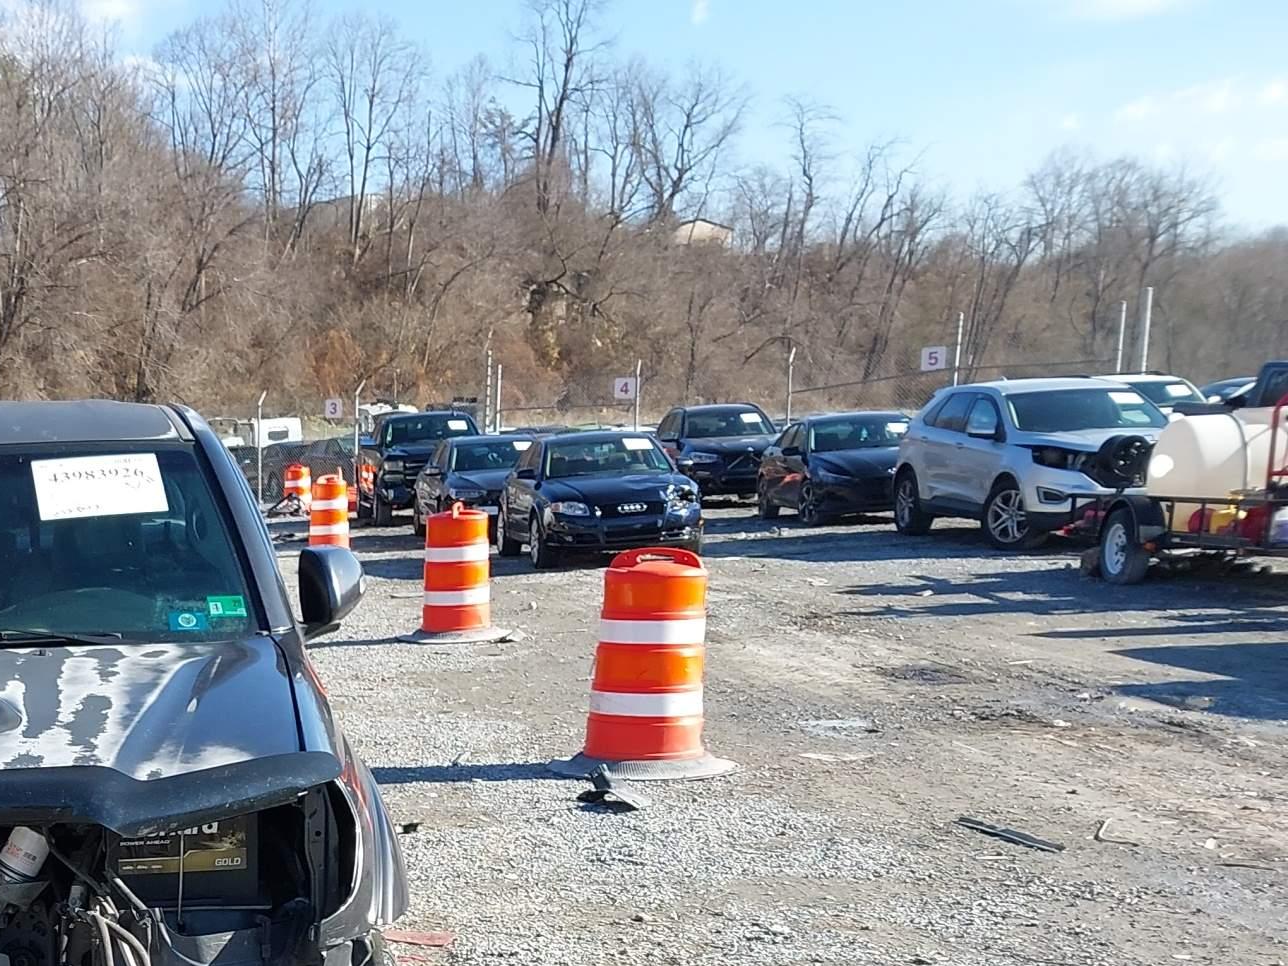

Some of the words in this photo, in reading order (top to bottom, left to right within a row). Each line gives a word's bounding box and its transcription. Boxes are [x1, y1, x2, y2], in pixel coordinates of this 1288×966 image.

[928, 351, 938, 366] 5
[620, 382, 630, 395] 4
[330, 402, 337, 415] 3
[215, 857, 241, 866] GOLD
